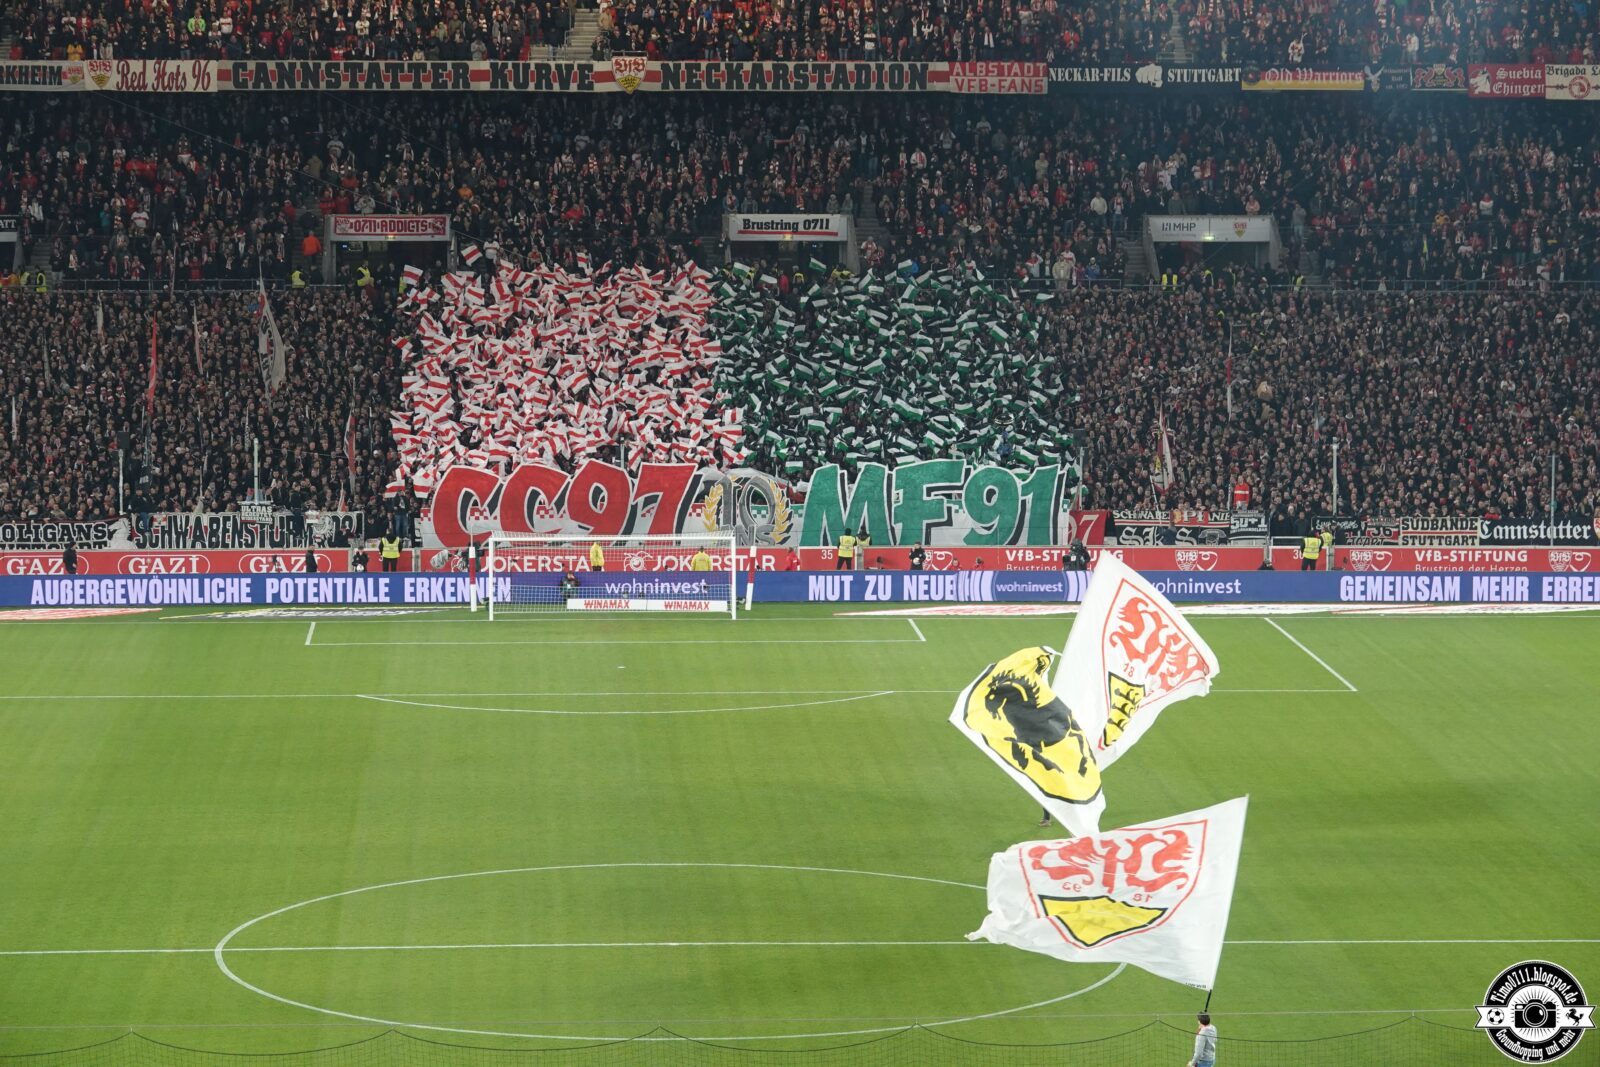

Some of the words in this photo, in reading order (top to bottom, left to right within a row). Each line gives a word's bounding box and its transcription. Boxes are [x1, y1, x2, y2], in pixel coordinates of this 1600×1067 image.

[116, 60, 148, 90] Red
[152, 60, 187, 90] Hots
[191, 60, 211, 90] 96
[232, 61, 470, 90] CANNSTATTER
[490, 61, 594, 90] KURVE
[661, 62, 928, 91] NECKARSTADION
[952, 62, 1046, 77] ALBSTADT
[1049, 67, 1132, 82] NECKAR-FILS
[1167, 67, 1242, 83] STUTTGART
[1265, 67, 1293, 84] Old
[1295, 67, 1364, 84] Warriors
[1495, 67, 1542, 80] Suebia
[954, 77, 1044, 92] VFB-FANS
[354, 219, 377, 233] 0711
[381, 219, 428, 232] ADDICTS
[742, 218, 800, 232] Brustring
[803, 218, 830, 230] 0711
[1173, 222, 1197, 232] MHP
[799, 459, 1064, 547] MF91
[1230, 516, 1268, 529] 50+1
[1480, 519, 1592, 541] Cannstatter
[1401, 535, 1477, 546] STUTTGART
[821, 549, 834, 560] 35
[1414, 550, 1528, 562] VfB-STIFTUNG
[480, 555, 605, 573] JOKERSTA
[266, 577, 390, 604] POTENTIALE
[404, 577, 511, 603] ERKENNEN
[604, 578, 708, 594] wohninvest
[808, 575, 854, 601] MUT
[864, 575, 892, 601] ZU
[996, 582, 1064, 593] wohninvest
[1340, 576, 1460, 602] GEMEINSAM
[1472, 576, 1529, 602] MEHR
[584, 599, 630, 609] WINAMAX
[664, 601, 710, 611] WINAMAX
